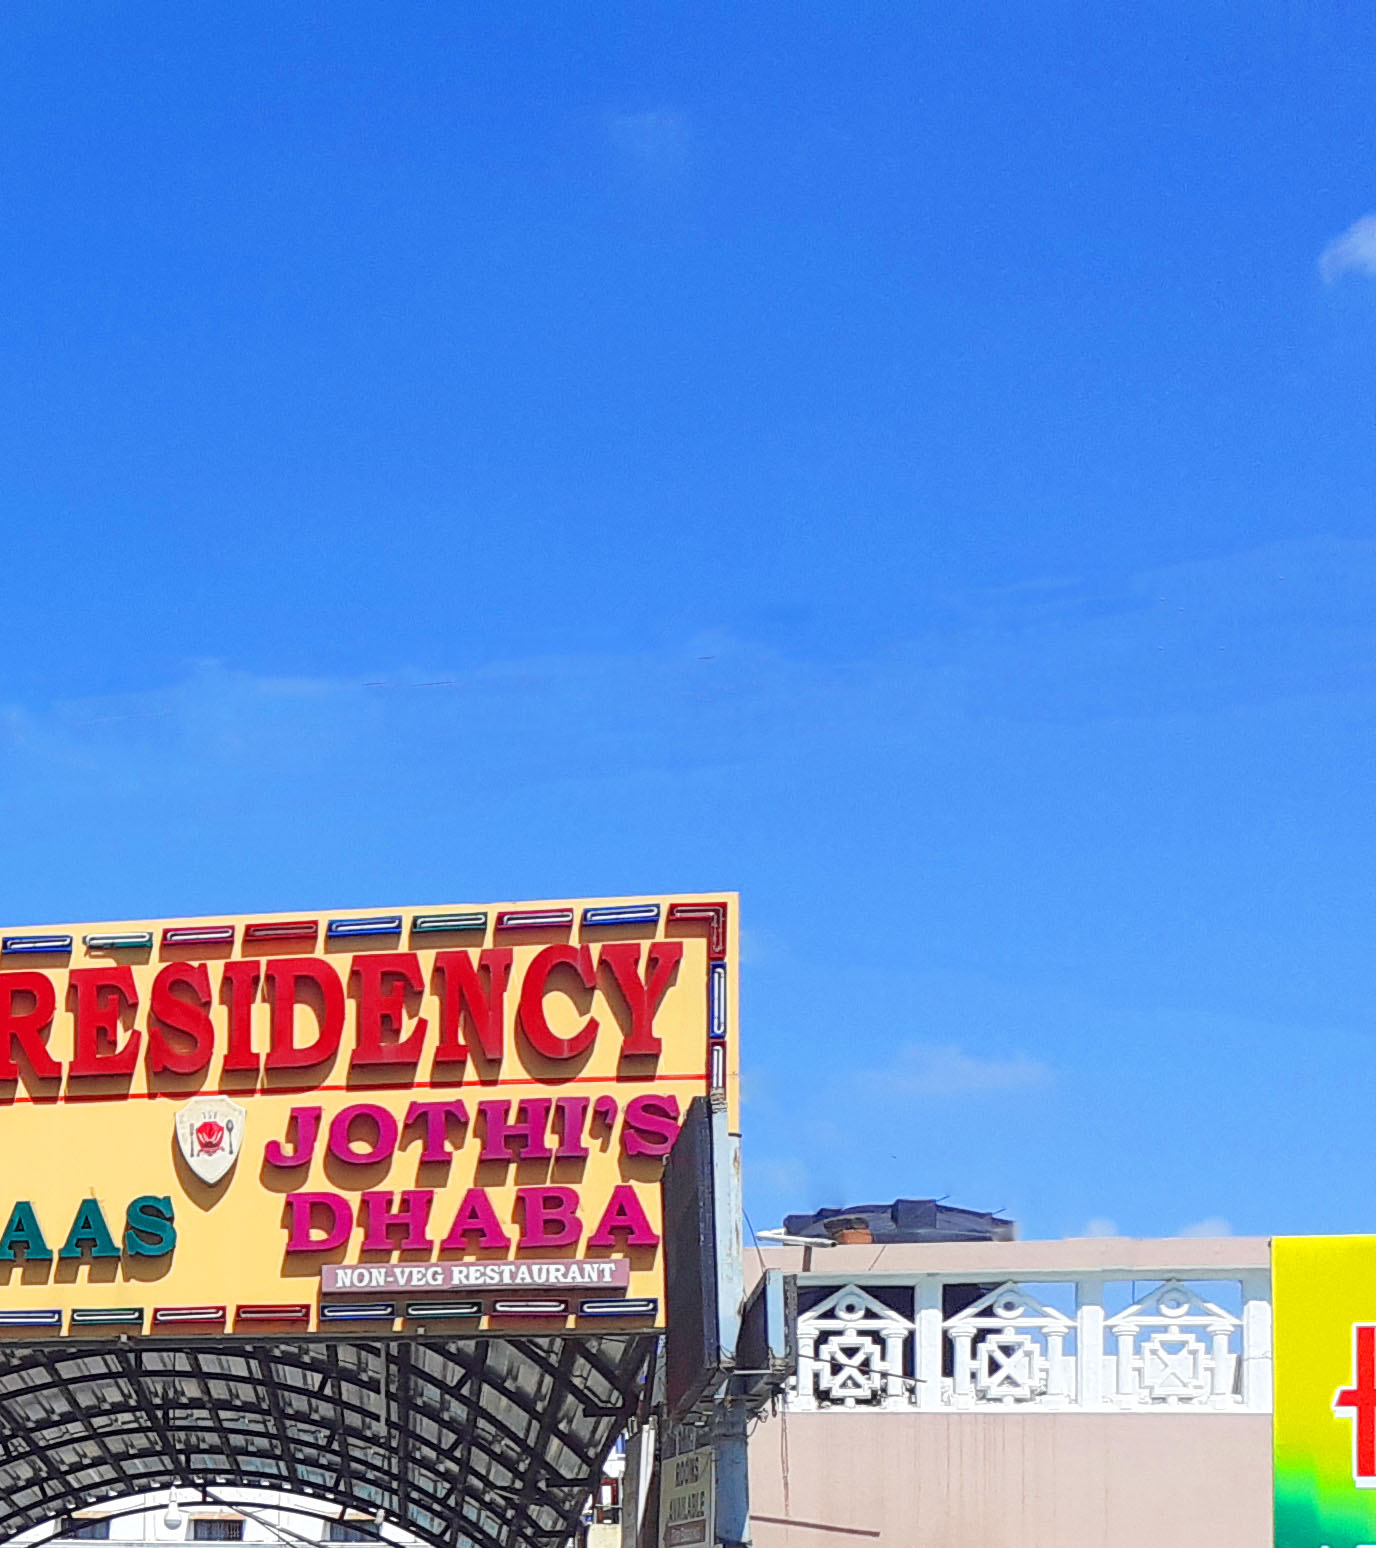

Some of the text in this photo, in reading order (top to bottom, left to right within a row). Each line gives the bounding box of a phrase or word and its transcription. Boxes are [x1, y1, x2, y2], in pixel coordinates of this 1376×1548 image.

[264, 1093, 682, 1168] JOTHI'S
[285, 1183, 661, 1253] DHABA
[335, 1261, 617, 1289] NON-VEG RESTAURANT
